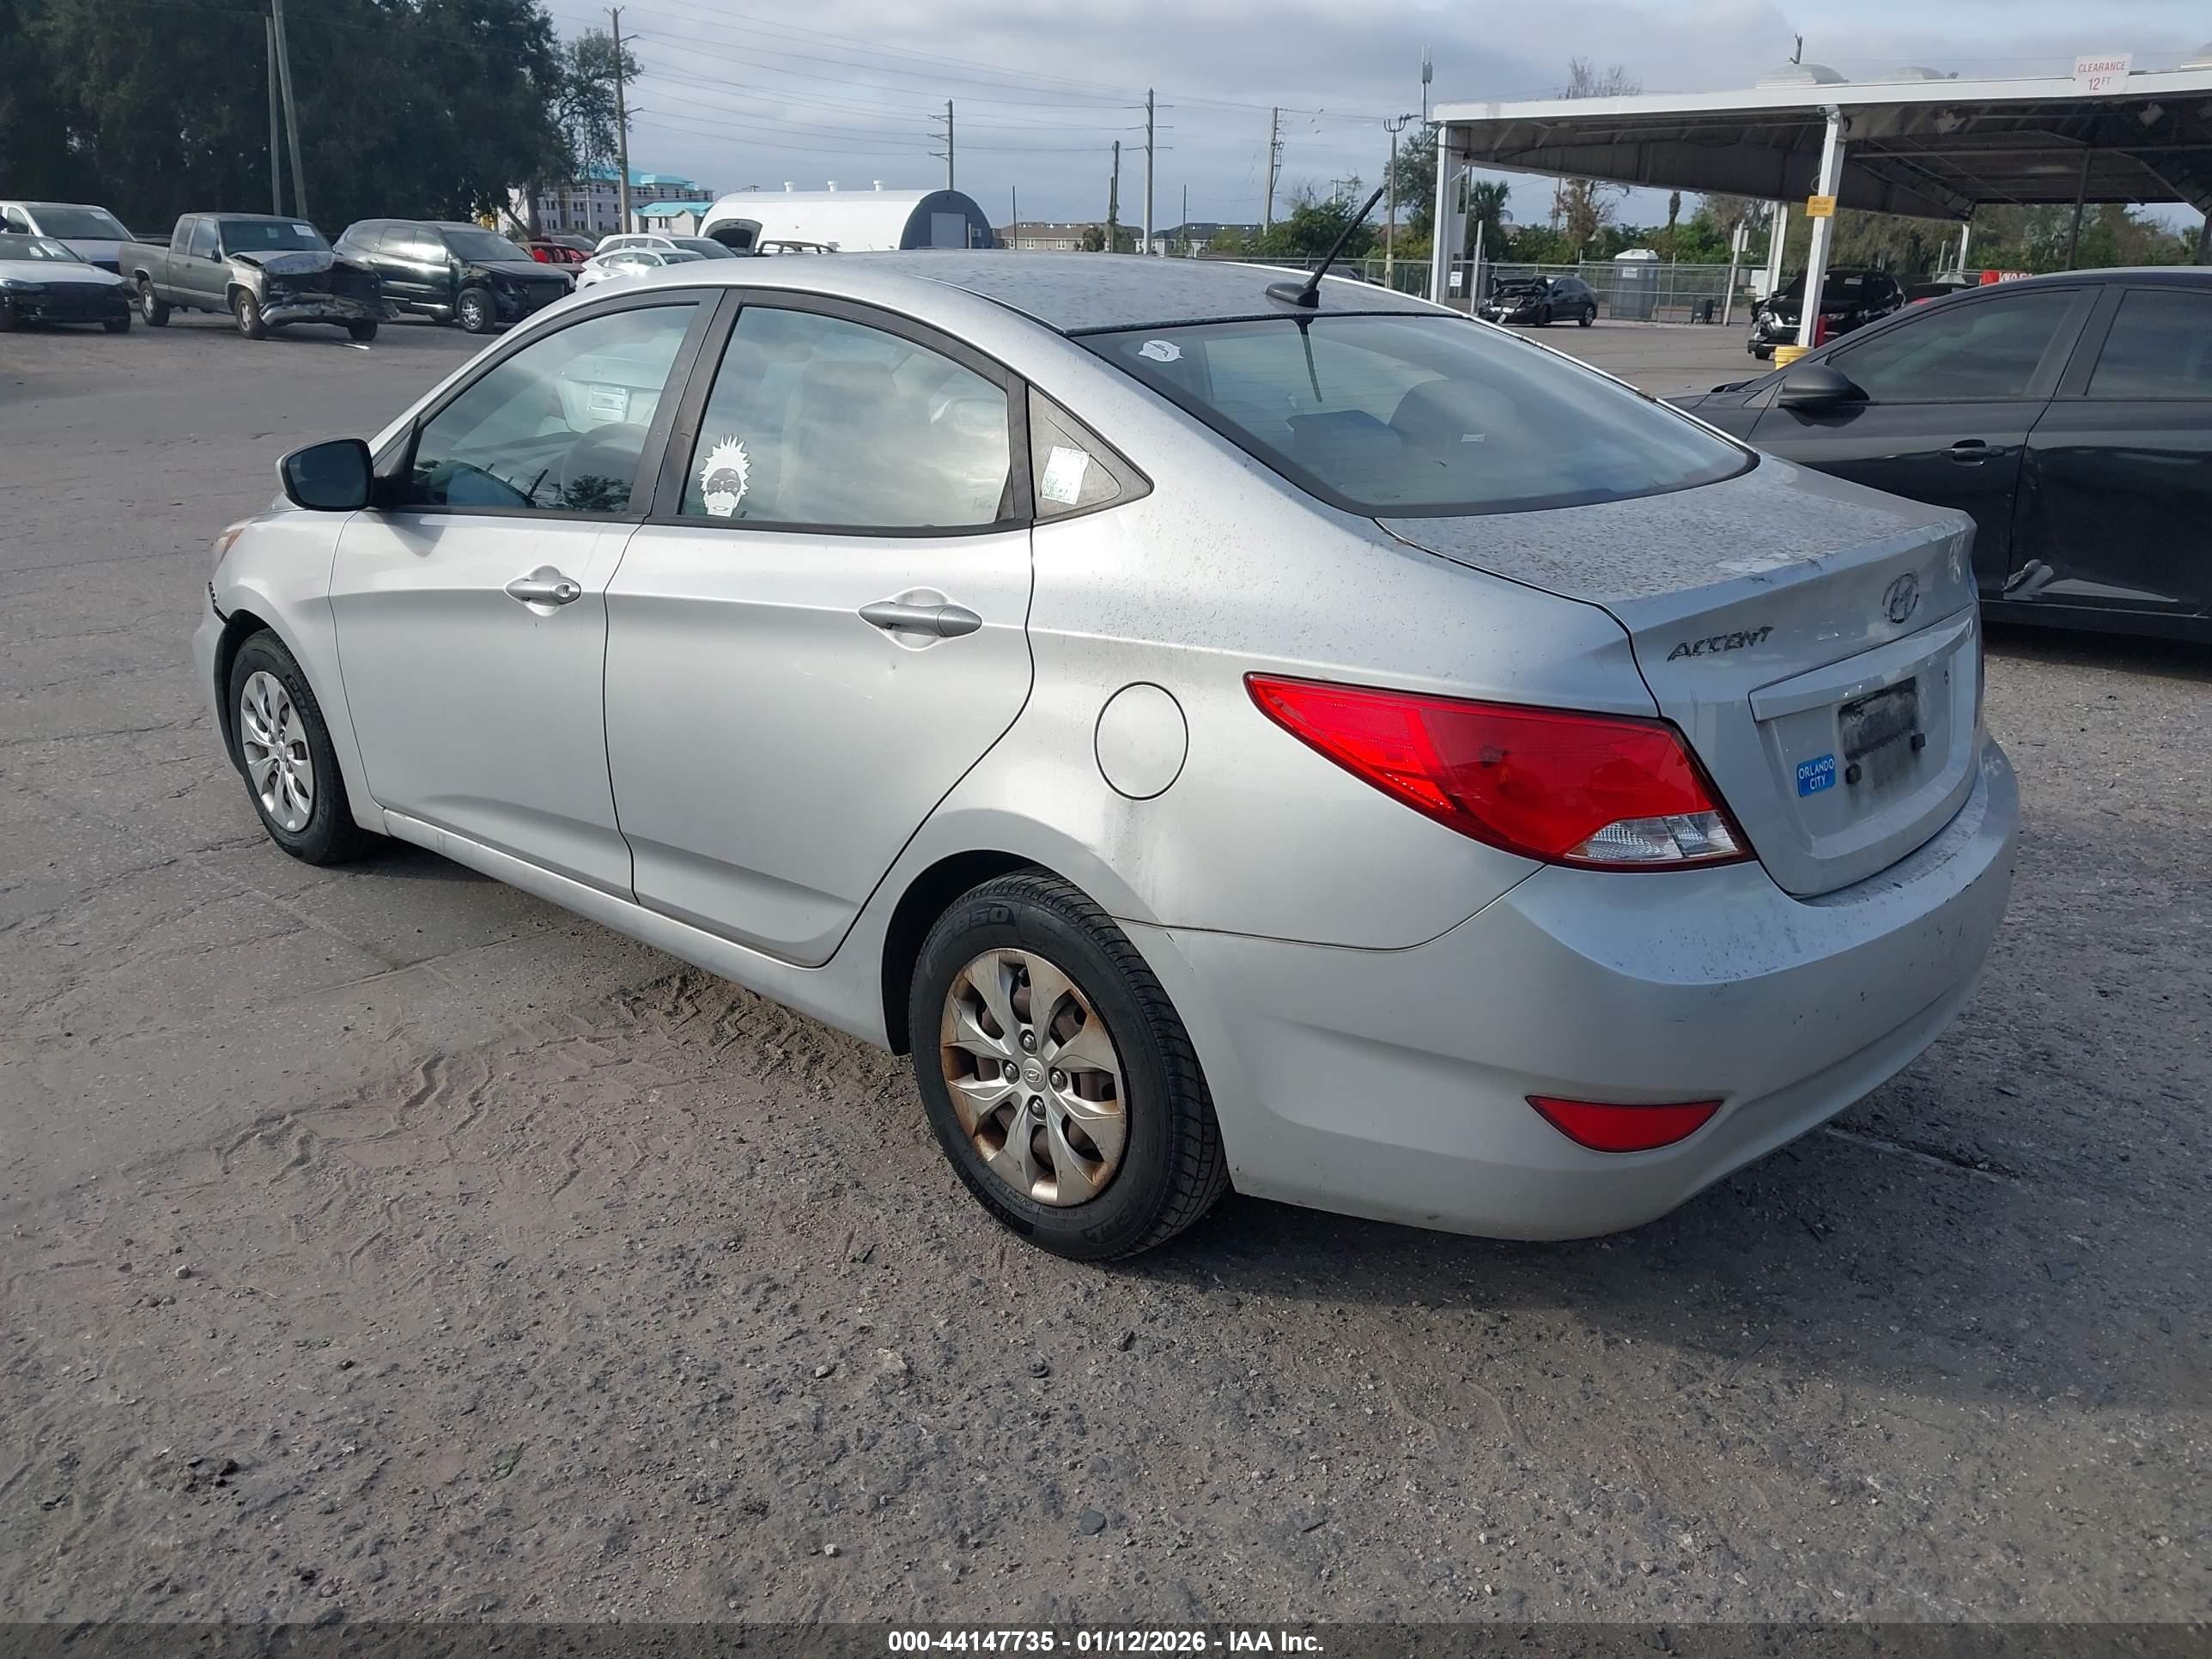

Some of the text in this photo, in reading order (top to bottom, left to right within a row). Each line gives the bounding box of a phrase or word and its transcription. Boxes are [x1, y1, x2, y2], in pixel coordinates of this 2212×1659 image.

[2078, 61, 2127, 73] CLEARANCE
[1667, 626, 1773, 662] ACCENT
[1798, 757, 1834, 781] ORLANDO
[1809, 774, 1827, 790] CITY
